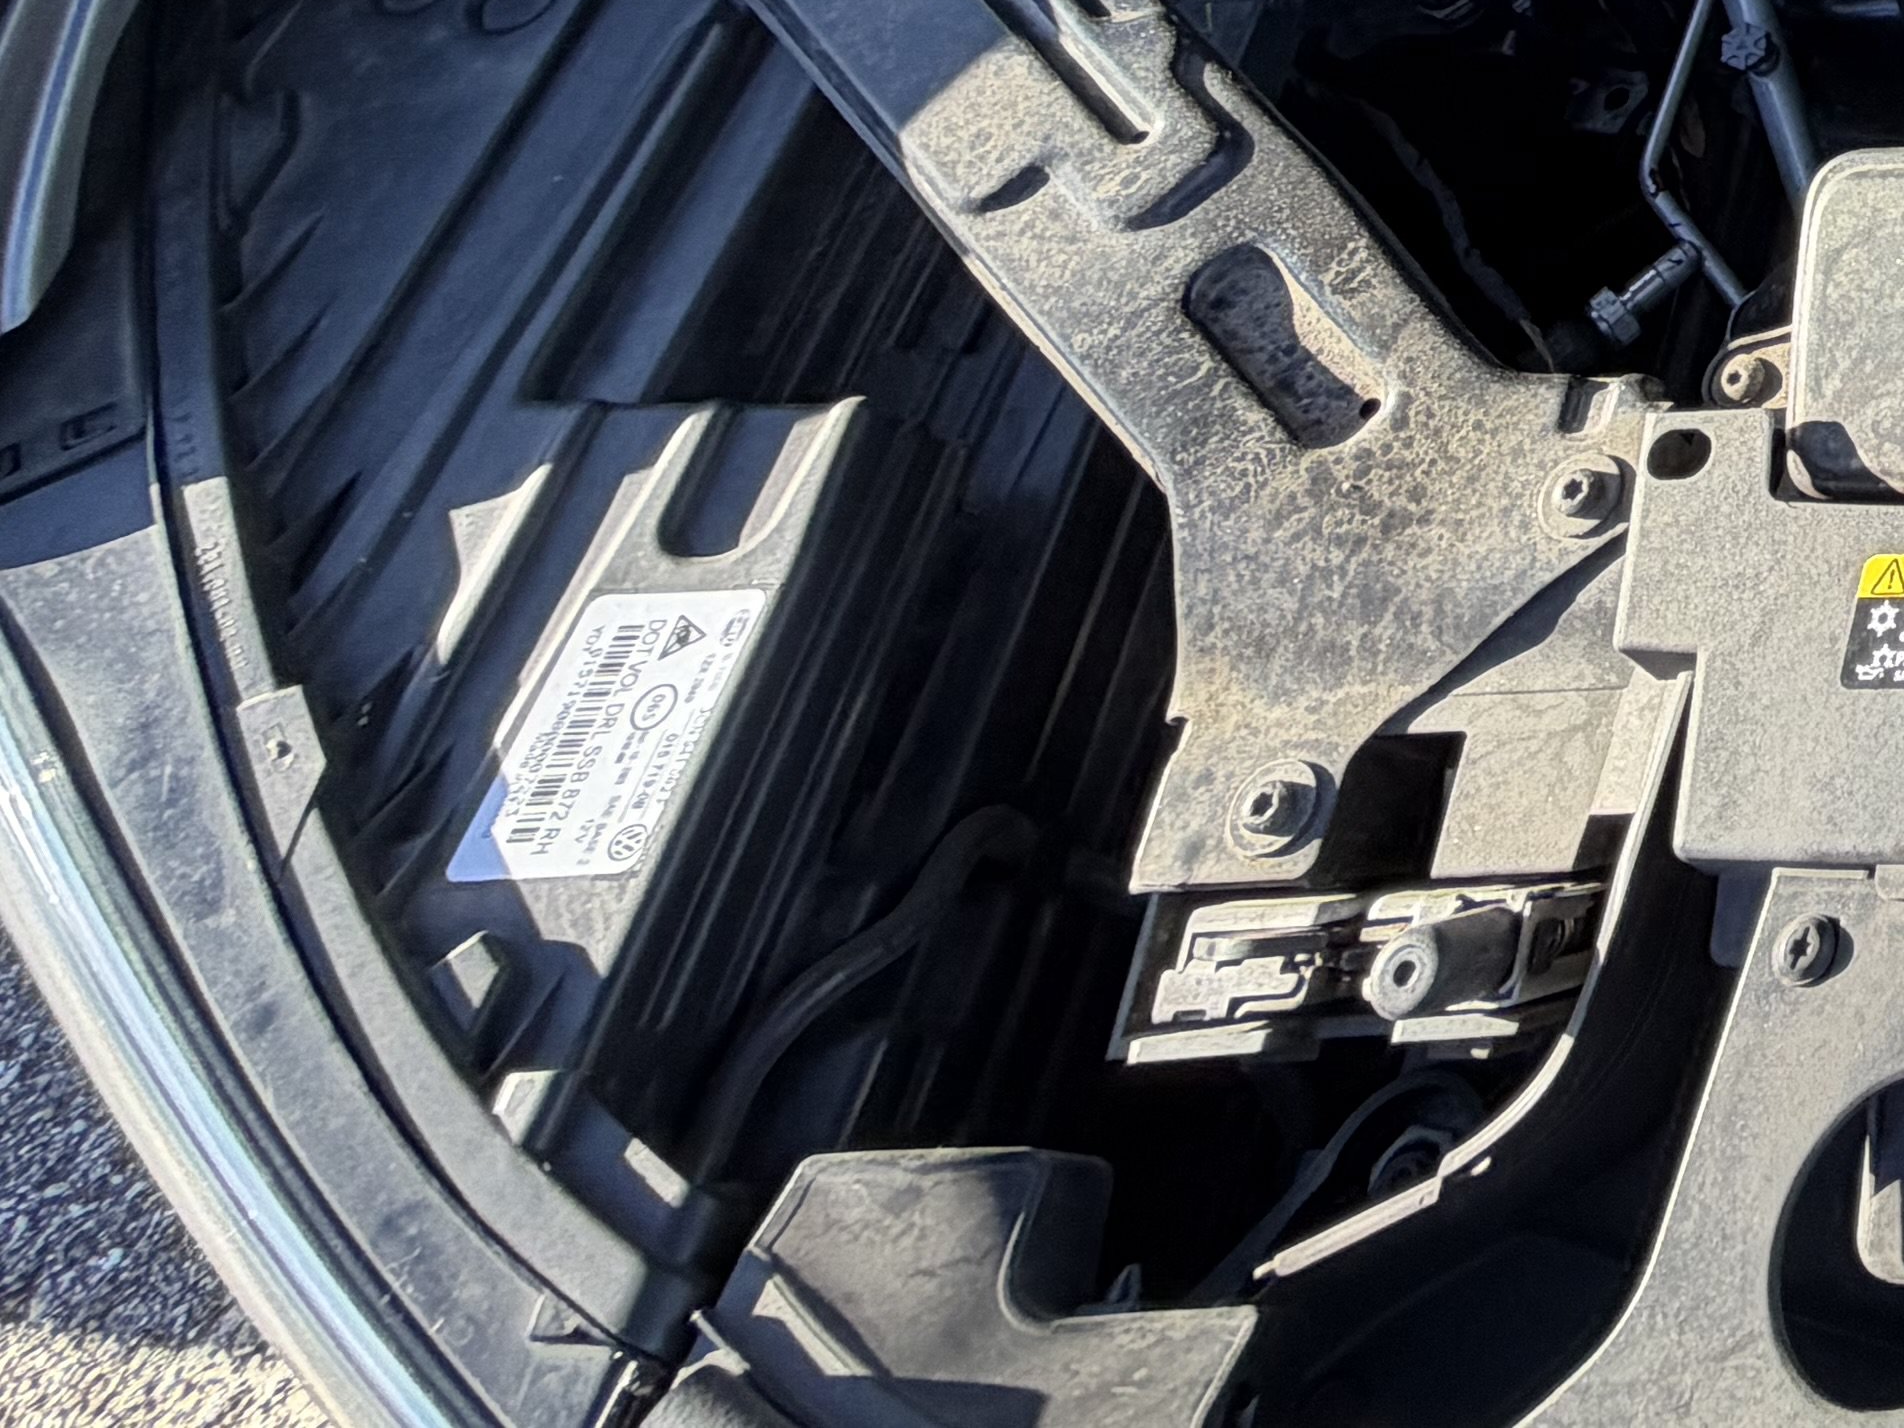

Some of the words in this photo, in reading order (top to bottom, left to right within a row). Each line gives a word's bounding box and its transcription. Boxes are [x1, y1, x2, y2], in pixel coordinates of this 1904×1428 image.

[642, 618, 669, 655] DOT
[616, 660, 648, 697] VOL
[590, 702, 625, 740] DRL
[570, 744, 603, 783] SSB
[549, 788, 581, 821] 872
[530, 827, 562, 855] RH
